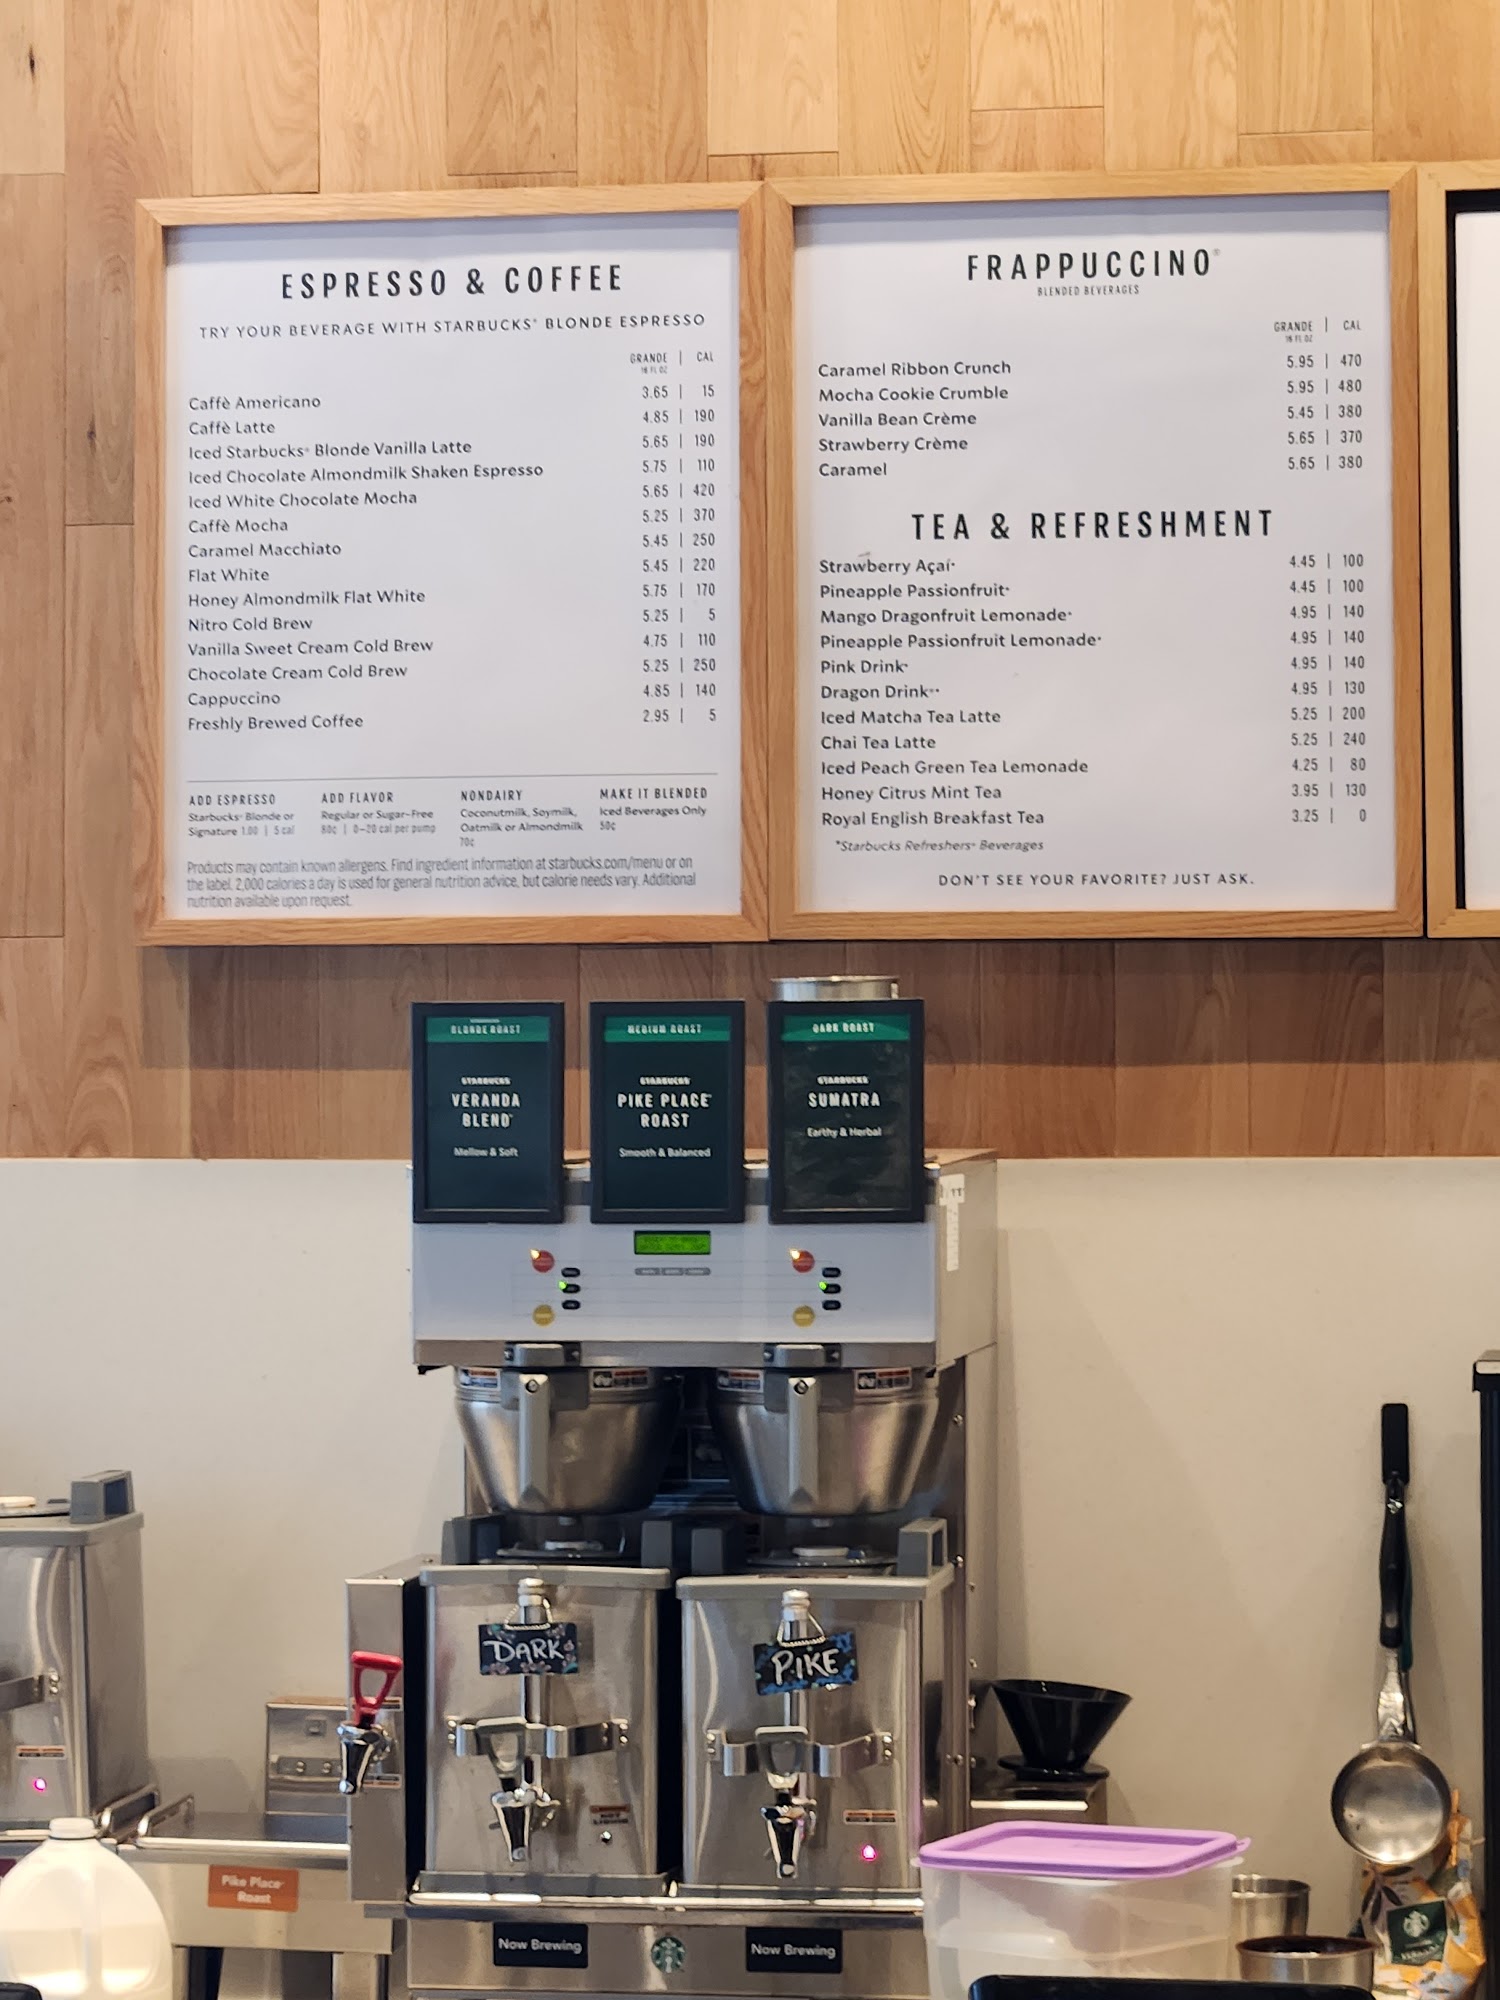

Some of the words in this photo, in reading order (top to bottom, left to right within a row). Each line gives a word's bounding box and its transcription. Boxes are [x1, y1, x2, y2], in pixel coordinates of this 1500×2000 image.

[282, 269, 445, 298] ESPRESSO
[465, 268, 484, 294] &
[504, 264, 620, 293] COFFEE
[1037, 286, 1080, 296] BLENDED
[1083, 284, 1139, 295] BEVERAGES
[199, 326, 228, 338] TRY
[236, 325, 281, 337] YOUR
[289, 322, 374, 336] BEVERAGE
[381, 321, 426, 333] WITH
[545, 316, 612, 329] BLONDE
[619, 313, 704, 328] ESPRESSO
[1273, 320, 1312, 332] GRANDE
[1343, 319, 1361, 331] CAL
[629, 352, 667, 363] GRANDE
[696, 351, 713, 362] CAL
[818, 363, 885, 377] Caramel
[891, 362, 948, 375] Ribbon
[953, 360, 1011, 375] Crunch
[1286, 354, 1314, 368] 5.95
[1340, 353, 1362, 367] 470
[189, 396, 230, 410] Caffè
[235, 395, 321, 409] Americano
[642, 385, 668, 399] 3.65
[702, 384, 714, 397] 15
[818, 438, 909, 453] Strawberry
[914, 436, 968, 450] Crème
[1287, 430, 1314, 444] 5.65
[1340, 429, 1362, 443] 370
[189, 470, 221, 484] Iced
[226, 469, 306, 483] Chocolate
[310, 466, 407, 481] Almondmilk
[411, 465, 468, 479] Shaken
[473, 464, 543, 479] Espresso
[642, 459, 667, 473] 5.75
[697, 458, 714, 471] 110
[818, 462, 887, 476] Caramel
[1288, 456, 1315, 470] 5.65
[1338, 455, 1362, 469] 380
[188, 519, 230, 533] Caffè
[235, 518, 288, 532] Mocha
[642, 509, 668, 523] 5.25
[693, 507, 715, 521] 370
[911, 513, 969, 540] TEA
[990, 512, 1009, 539] &
[1030, 509, 1272, 538] REFRESHMENT
[188, 543, 253, 557] Caramel
[259, 542, 341, 556] Macchiato
[642, 533, 668, 547] 5.45
[692, 532, 715, 546] 250
[819, 558, 911, 575] Strawberry
[1289, 554, 1315, 568] 4.45
[1342, 553, 1364, 567] 100
[188, 594, 238, 609] Honey
[242, 591, 340, 605] Almondmilk
[344, 590, 372, 603] Flat
[376, 589, 425, 602] White
[642, 583, 667, 597] 5.75
[696, 582, 715, 596] 170
[188, 618, 227, 631] Nitro
[232, 617, 267, 631] Cold
[273, 617, 312, 630] Brew
[642, 608, 668, 622] 5.25
[708, 607, 715, 621] 5
[187, 691, 280, 708] Cappuccino
[643, 683, 670, 697] 4.85
[695, 683, 716, 696] 140
[188, 716, 243, 732] Freshly
[247, 715, 307, 729] Brewed
[311, 714, 363, 728] Coffee
[642, 708, 669, 722] 2.95
[708, 708, 716, 721] 5
[821, 710, 855, 724] Iced
[860, 710, 922, 723] Matcha
[926, 710, 954, 723] Tea
[959, 710, 1001, 723] Latte
[1290, 706, 1317, 720] 5.25
[1342, 706, 1365, 720] 200
[820, 735, 856, 749] Chai
[861, 735, 889, 749] Tea
[894, 736, 936, 749] Latte
[1290, 732, 1318, 746] 5.25
[1343, 731, 1365, 745] 240
[189, 794, 212, 806] ADD
[217, 793, 275, 805] ESPRESSO
[321, 792, 344, 803] ADD
[349, 791, 393, 803] FLAVOR
[460, 789, 522, 801] NONDAIRY
[599, 788, 632, 799] MAKE
[638, 787, 648, 799] IT
[654, 787, 707, 799] BLENDED
[821, 786, 874, 802] Honey
[878, 786, 926, 799] Citrus
[931, 785, 969, 799] Mint
[974, 785, 1001, 798] Tea
[1291, 783, 1319, 797] 3.95
[1345, 782, 1366, 797] 130
[599, 806, 622, 816] Iced
[624, 806, 680, 817] Beverages
[681, 805, 706, 816] Only
[821, 811, 865, 828] Royal
[871, 811, 928, 828] English
[933, 810, 1012, 824] Breakfast
[1016, 810, 1044, 824] Tea
[1291, 808, 1319, 822] 3.25
[1359, 808, 1367, 822] 0
[938, 874, 989, 886] DON'T
[996, 874, 1023, 886] SEE
[1029, 874, 1074, 885] YOUR
[1081, 873, 1166, 885] FAVORITE?
[1173, 873, 1210, 884] JUST
[1217, 873, 1253, 884] ASK.
[627, 1024, 666, 1034] MEDIUM
[669, 1023, 701, 1034] ROAST
[812, 1022, 839, 1033] DARK
[842, 1022, 874, 1032] ROAST
[451, 1092, 520, 1107] VERANDA
[617, 1093, 653, 1108] PIKE
[808, 1092, 880, 1107] SUMATRA
[640, 1112, 689, 1127] ROAST
[807, 1127, 838, 1138] Earthy
[839, 1126, 848, 1136] &
[848, 1126, 882, 1136] Herbal
[618, 1147, 657, 1157] Smooth
[657, 1147, 666, 1157] &
[666, 1147, 711, 1157] Balanced
[483, 1638, 564, 1664] DARK
[771, 1648, 840, 1686] PIKE
[221, 1874, 247, 1887] Pike
[236, 1890, 272, 1904] Roast
[498, 1937, 528, 1950] Now
[531, 1938, 583, 1954] Brewing
[751, 1943, 782, 1957] Now
[785, 1944, 836, 1960] Brewing
